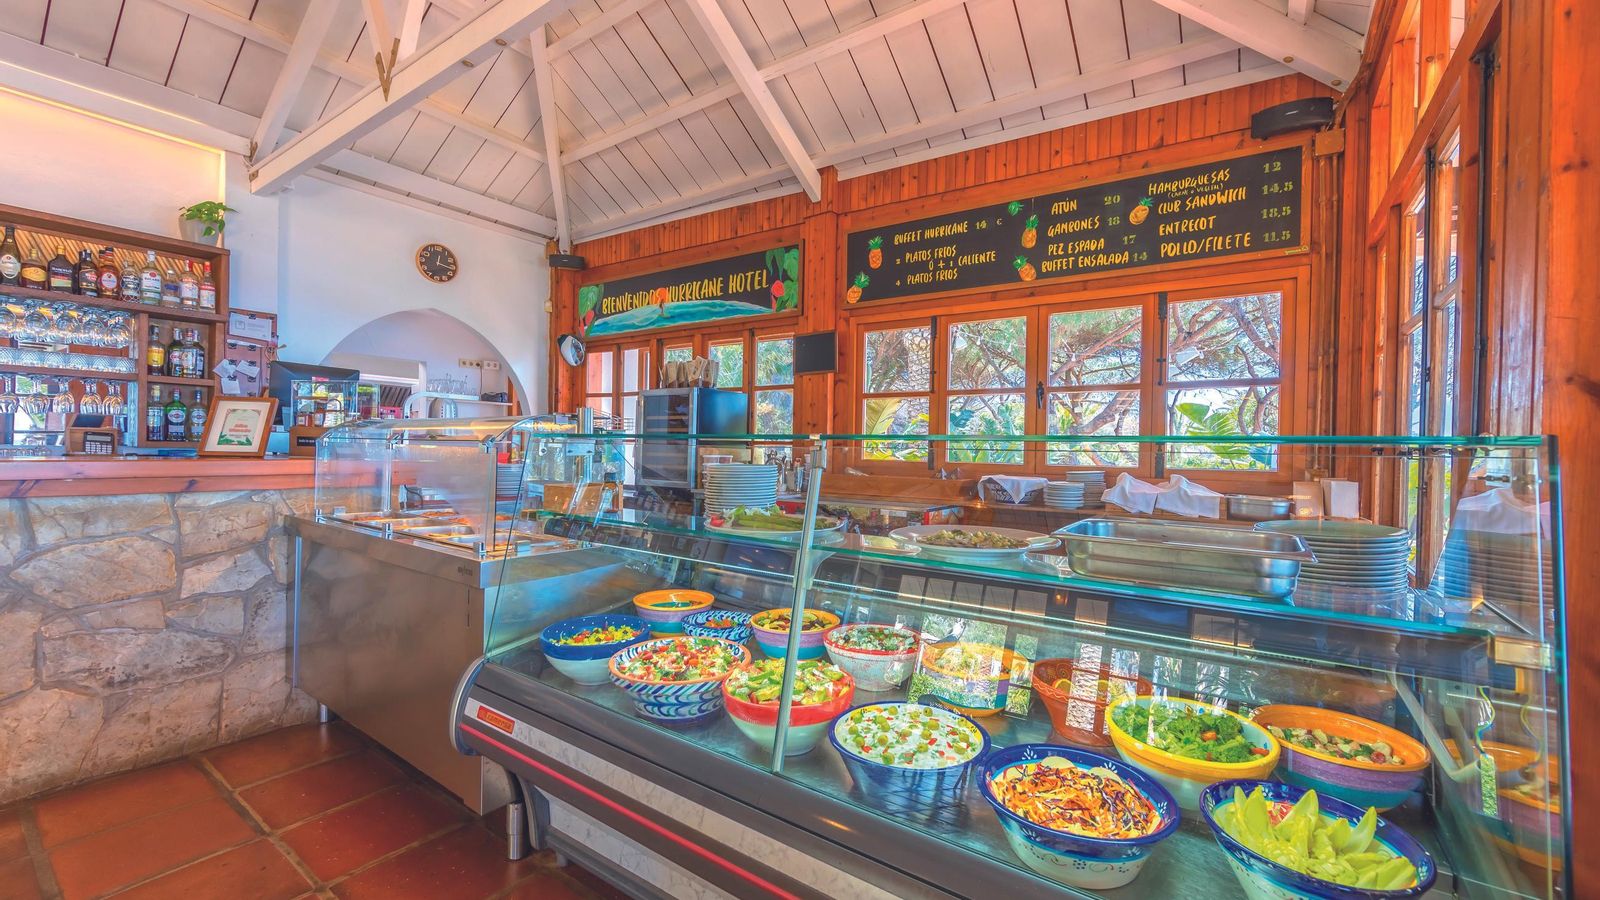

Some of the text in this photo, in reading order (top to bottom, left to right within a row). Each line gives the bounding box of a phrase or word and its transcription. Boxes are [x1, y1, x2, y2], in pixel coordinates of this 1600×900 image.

[1148, 161, 1281, 196] HAMBURGUESAS 12
[1051, 194, 1121, 215] ATÚN 20
[1158, 200, 1181, 215] CLUB
[1185, 186, 1247, 211] SANDWICH
[894, 230, 922, 245] BUFFET
[924, 221, 968, 240] HURRICANE
[1047, 215, 1120, 237] GAMBONES 18
[1159, 215, 1217, 236] ENTRECOT
[905, 249, 932, 263] PLATOS
[934, 245, 957, 259] FRIOS
[1048, 234, 1136, 256] PEZ ESPADA 17
[1160, 232, 1251, 258] POLLO/FILETE
[958, 251, 997, 267] CALIENTE
[1041, 257, 1075, 273] BUFFET
[1078, 251, 1129, 268] ENSALADA
[907, 272, 933, 285] PLATOS
[936, 268, 958, 281] FRIOS
[602, 269, 769, 315] BIENVENIDOS HURRICANE HOTEL
